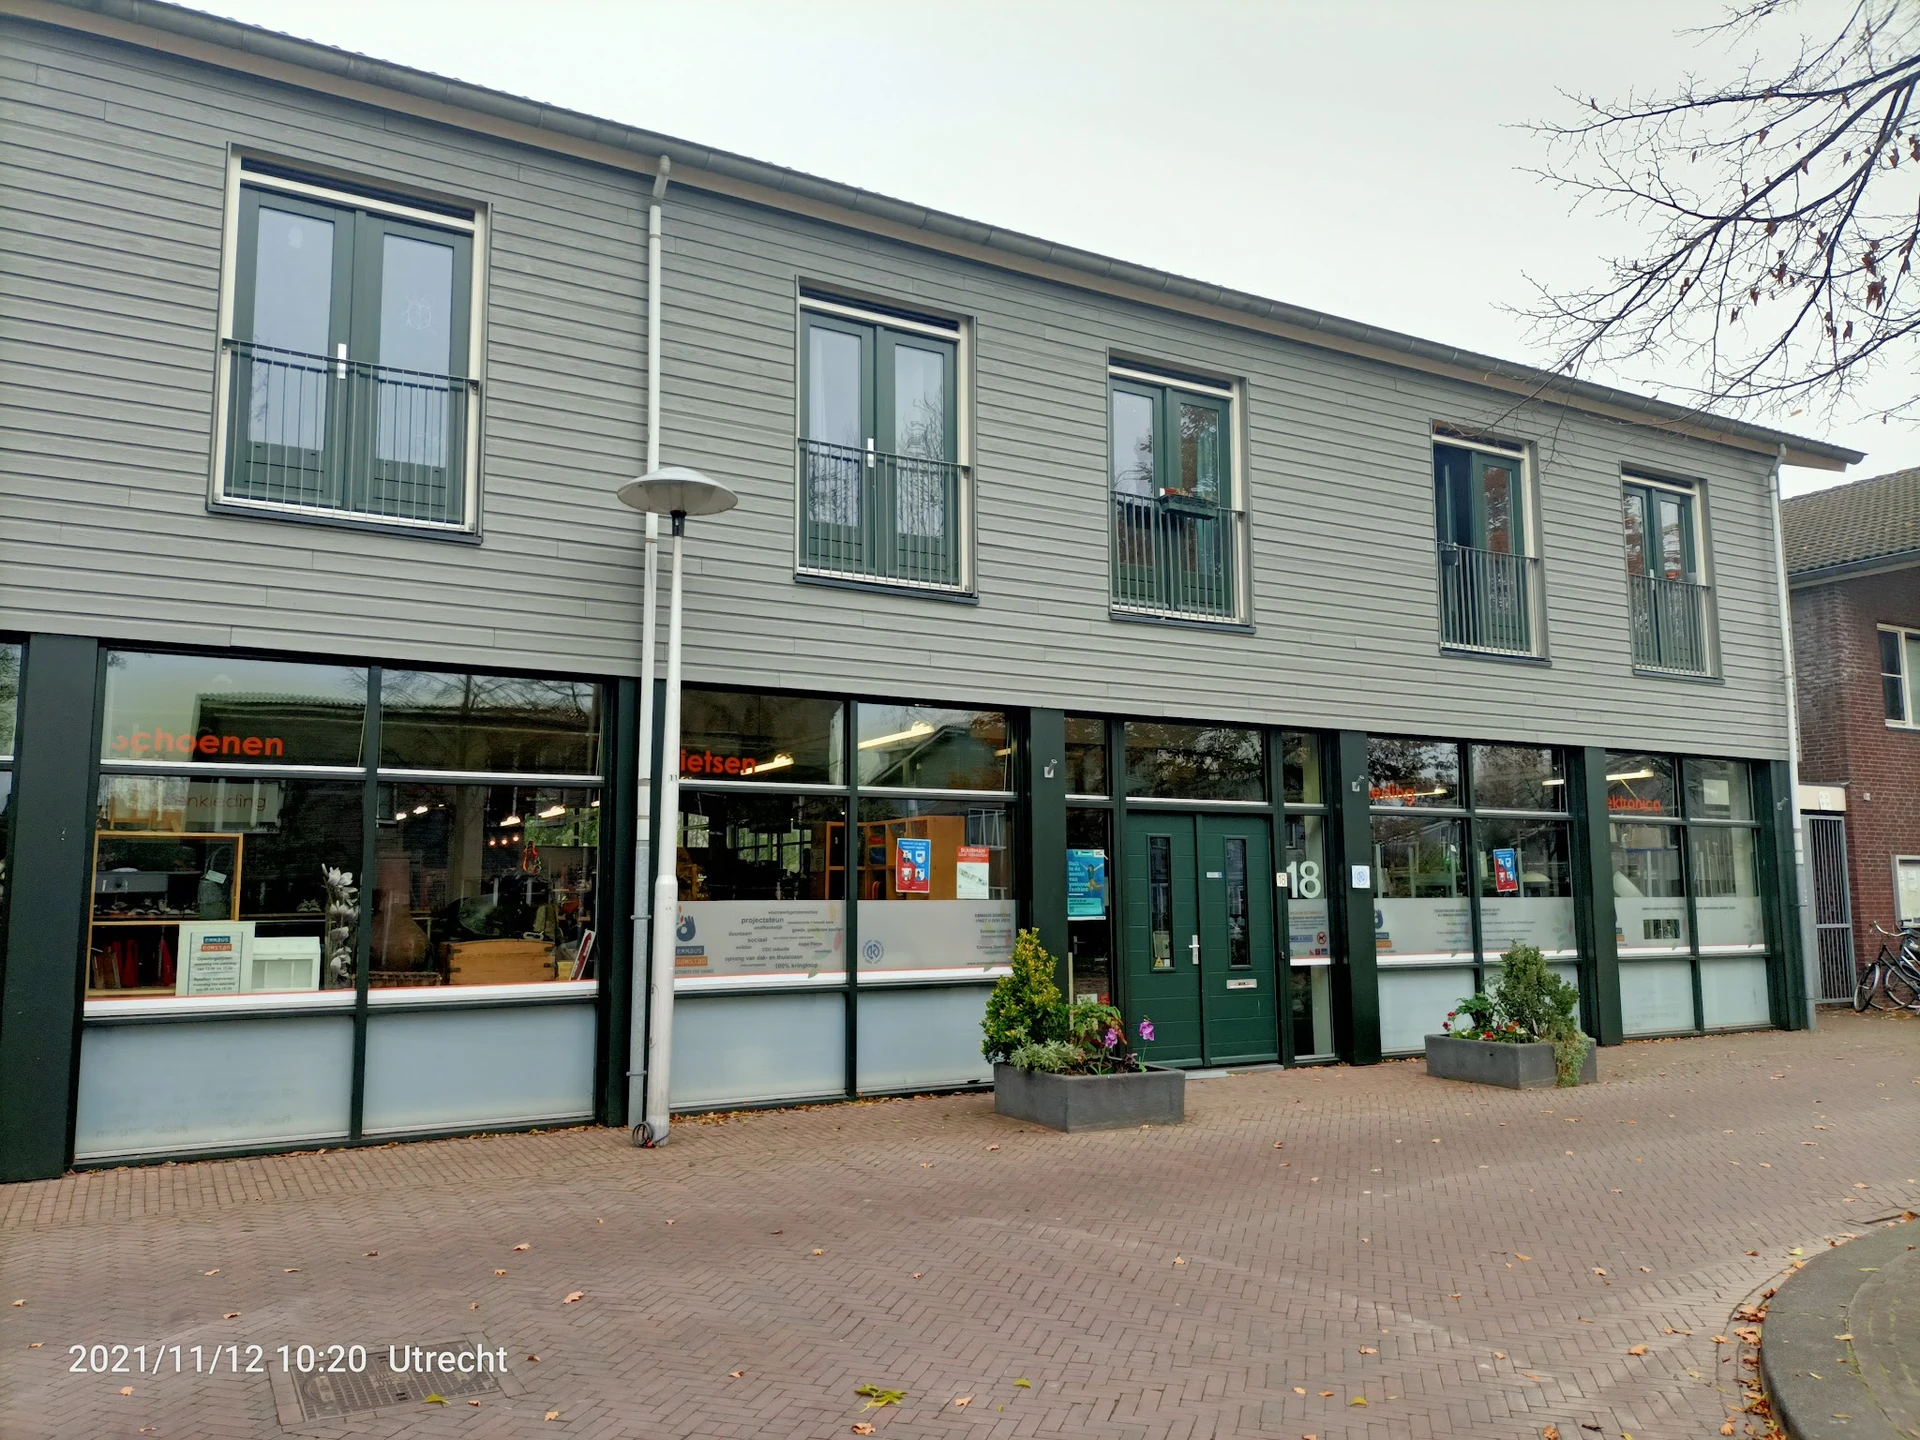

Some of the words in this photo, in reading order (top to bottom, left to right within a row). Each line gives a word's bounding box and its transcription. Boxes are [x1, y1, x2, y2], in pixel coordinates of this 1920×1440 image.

[680, 749, 757, 775] ietsen
[1278, 874, 1286, 886] 18
[1286, 861, 1321, 899] 18
[740, 916, 784, 925] projectsteun
